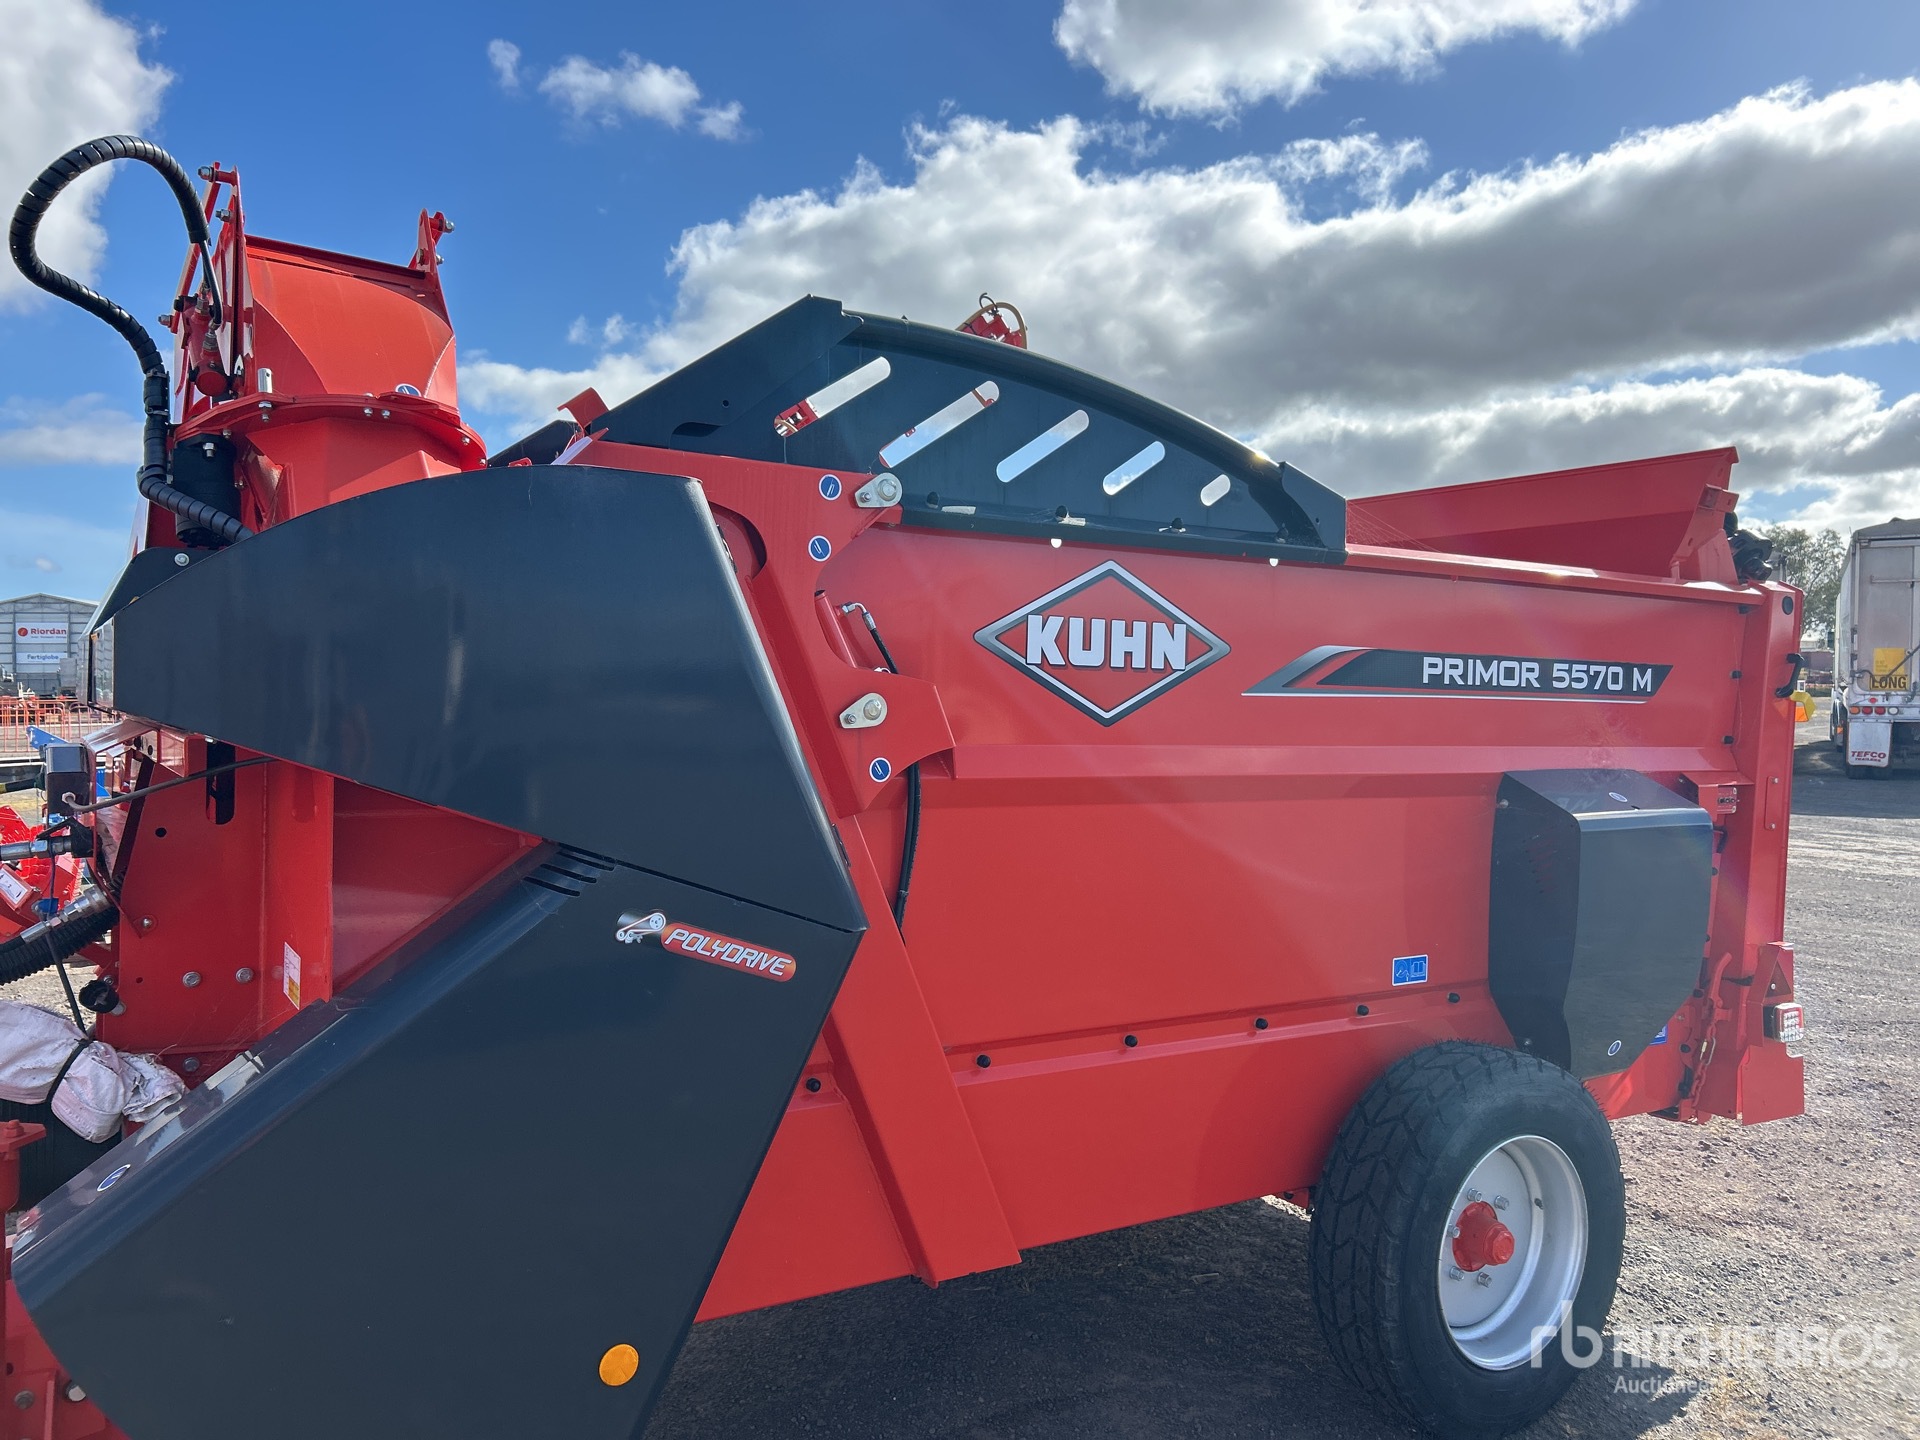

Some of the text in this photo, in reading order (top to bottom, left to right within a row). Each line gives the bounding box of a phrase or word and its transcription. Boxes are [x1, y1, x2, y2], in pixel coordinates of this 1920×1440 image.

[1026, 614, 1187, 671] KUHN
[1423, 656, 1652, 692] PRIMOR 5570 M
[1871, 676, 1907, 689] LONG
[1851, 751, 1886, 759] TEFCO
[664, 928, 791, 976] POLYDRIVE
